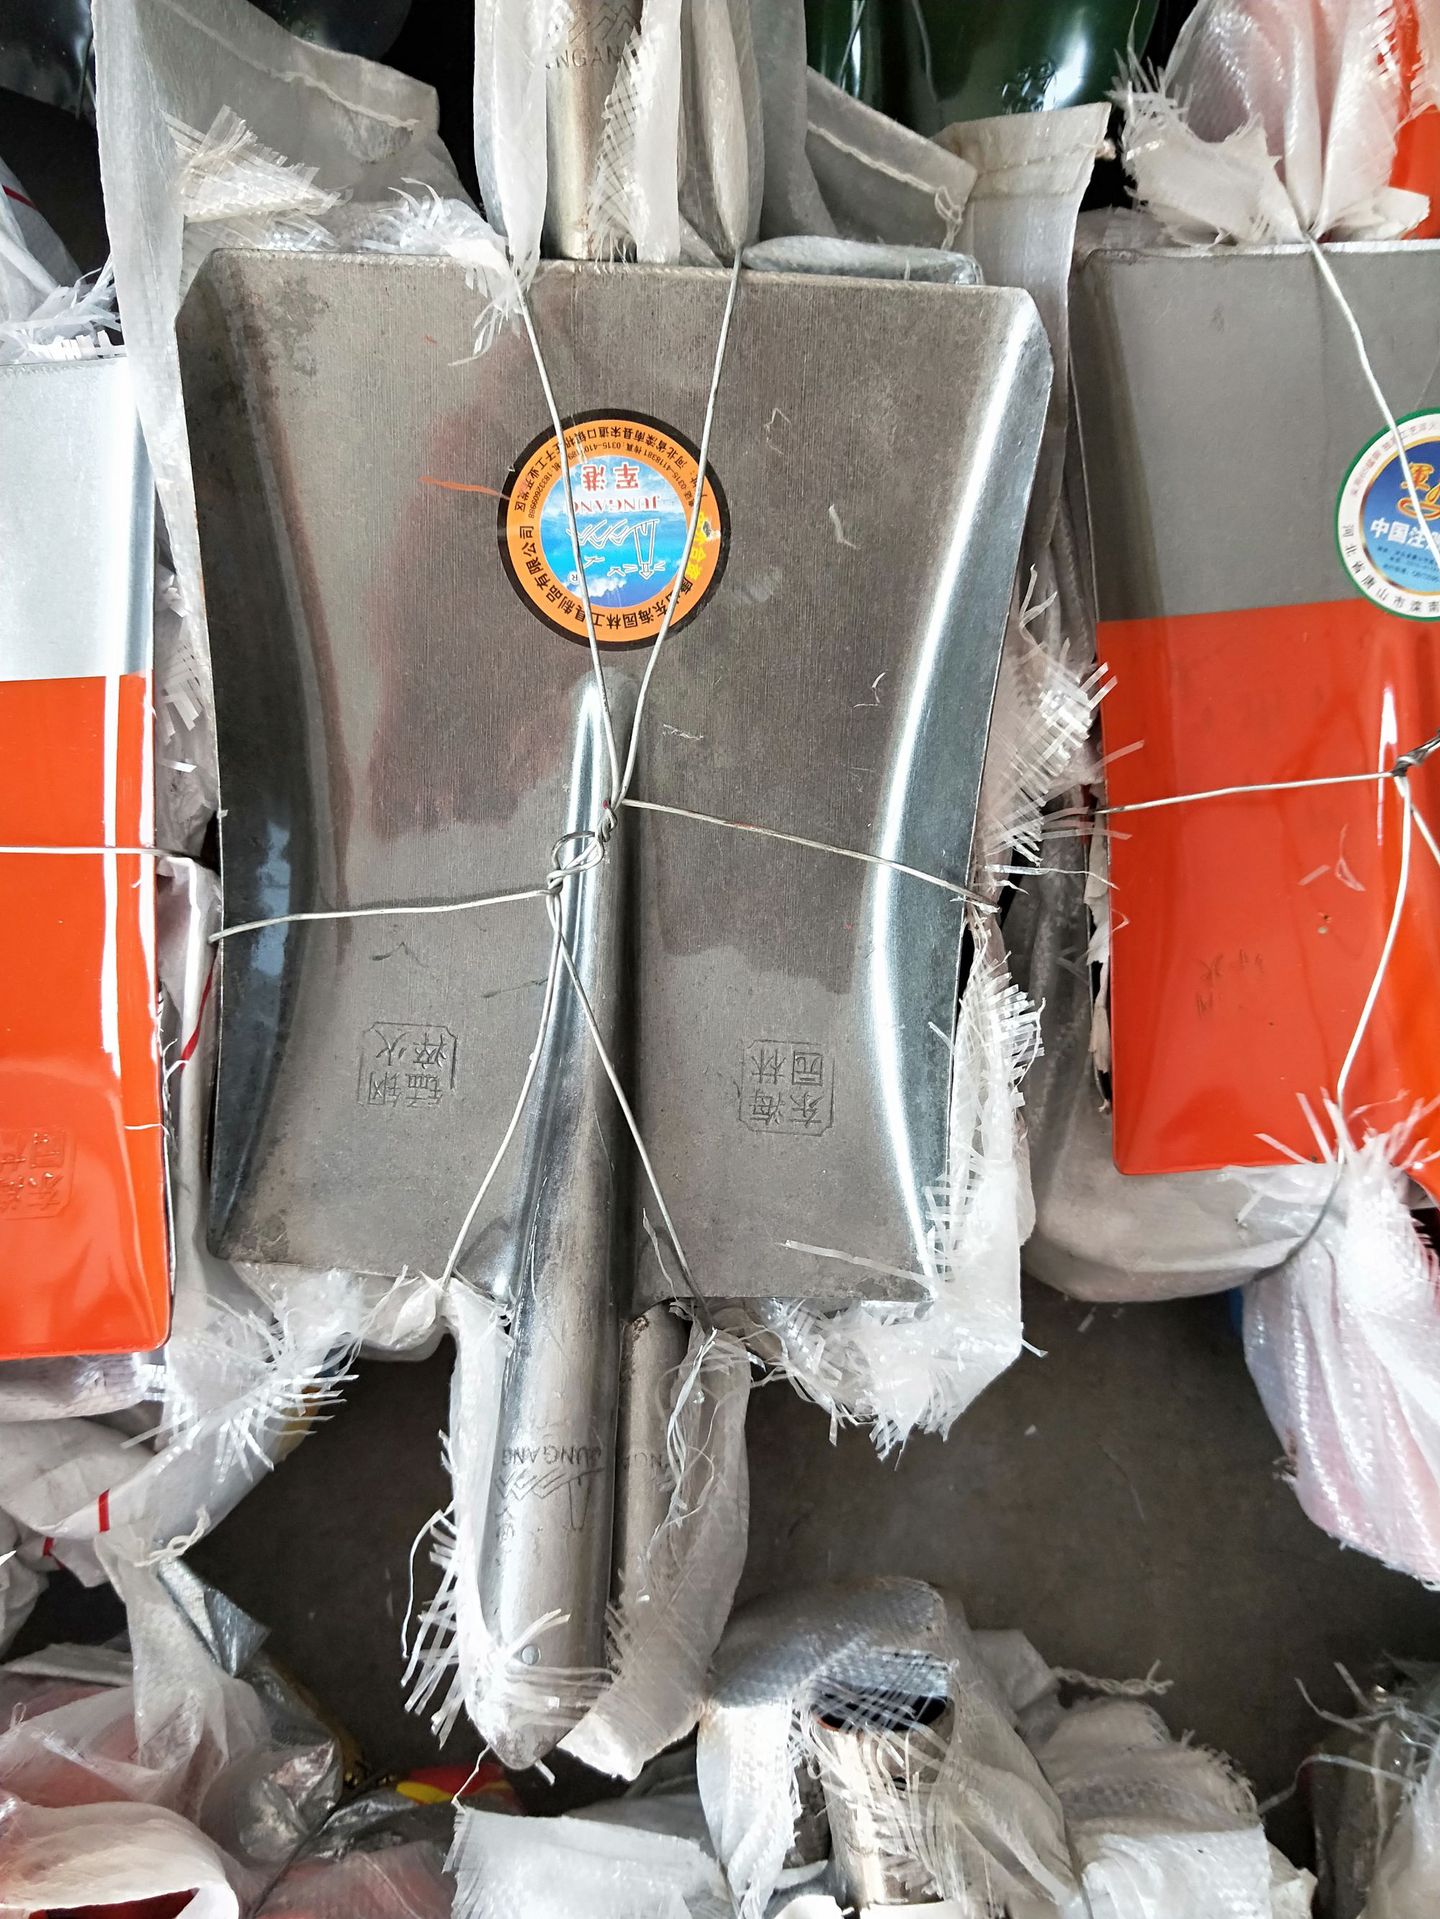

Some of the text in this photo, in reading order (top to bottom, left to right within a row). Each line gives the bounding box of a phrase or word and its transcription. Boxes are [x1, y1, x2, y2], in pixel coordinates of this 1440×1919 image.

[583, 464, 639, 492] 军港
[751, 1049, 823, 1087] 园林
[749, 1090, 824, 1128] 东海
